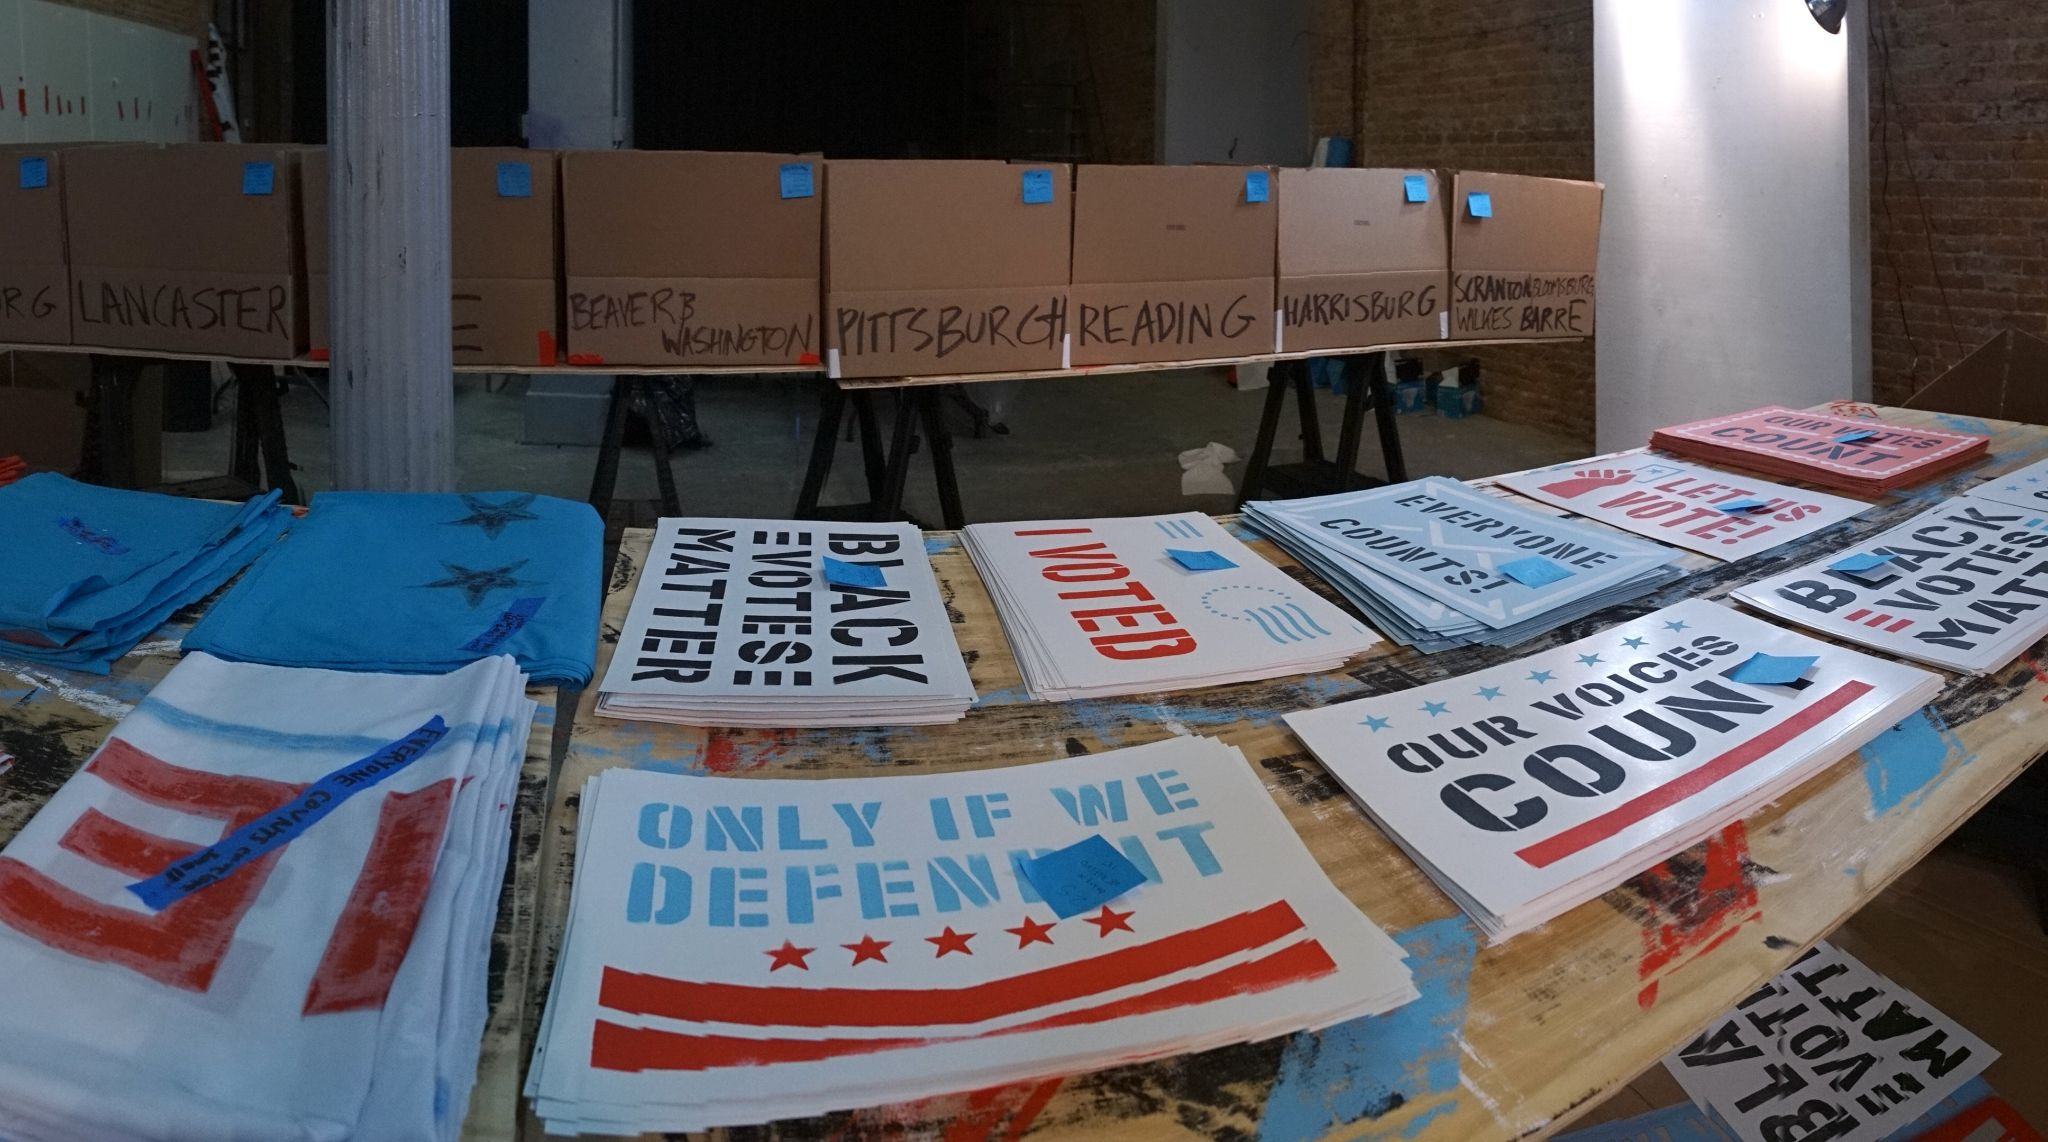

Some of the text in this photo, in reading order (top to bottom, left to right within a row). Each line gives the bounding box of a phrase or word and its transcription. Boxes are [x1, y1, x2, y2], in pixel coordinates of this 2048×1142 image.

[79, 280, 289, 340] LANCASTER
[570, 287, 676, 330] BEAVER
[1283, 284, 1437, 327] HARRISBURG
[1454, 273, 1532, 303] SCRANTON
[1456, 299, 1587, 333] WILKES BARRE
[661, 313, 813, 357] WASHINGTON
[838, 296, 1069, 358] PITTSBURGH
[1080, 296, 1256, 346] READING
[1711, 427, 1904, 466] COUNT
[1764, 415, 1832, 431] OUR
[1600, 490, 1776, 545] VOTE!
[1653, 477, 1822, 522] LET US
[1319, 517, 1510, 593] COUNTS!
[1394, 494, 1619, 569] EVERYONE
[1775, 507, 2024, 613] BLACK
[1014, 528, 1198, 661] I VOTED
[1876, 531, 2048, 612] VOTES
[631, 527, 736, 683] MATTER
[1386, 635, 1740, 774] OUR VOICES
[1440, 655, 1815, 832] COUN
[250, 728, 441, 845] EVERYONE COUNTS
[637, 769, 1200, 853] ONLY IF WE
